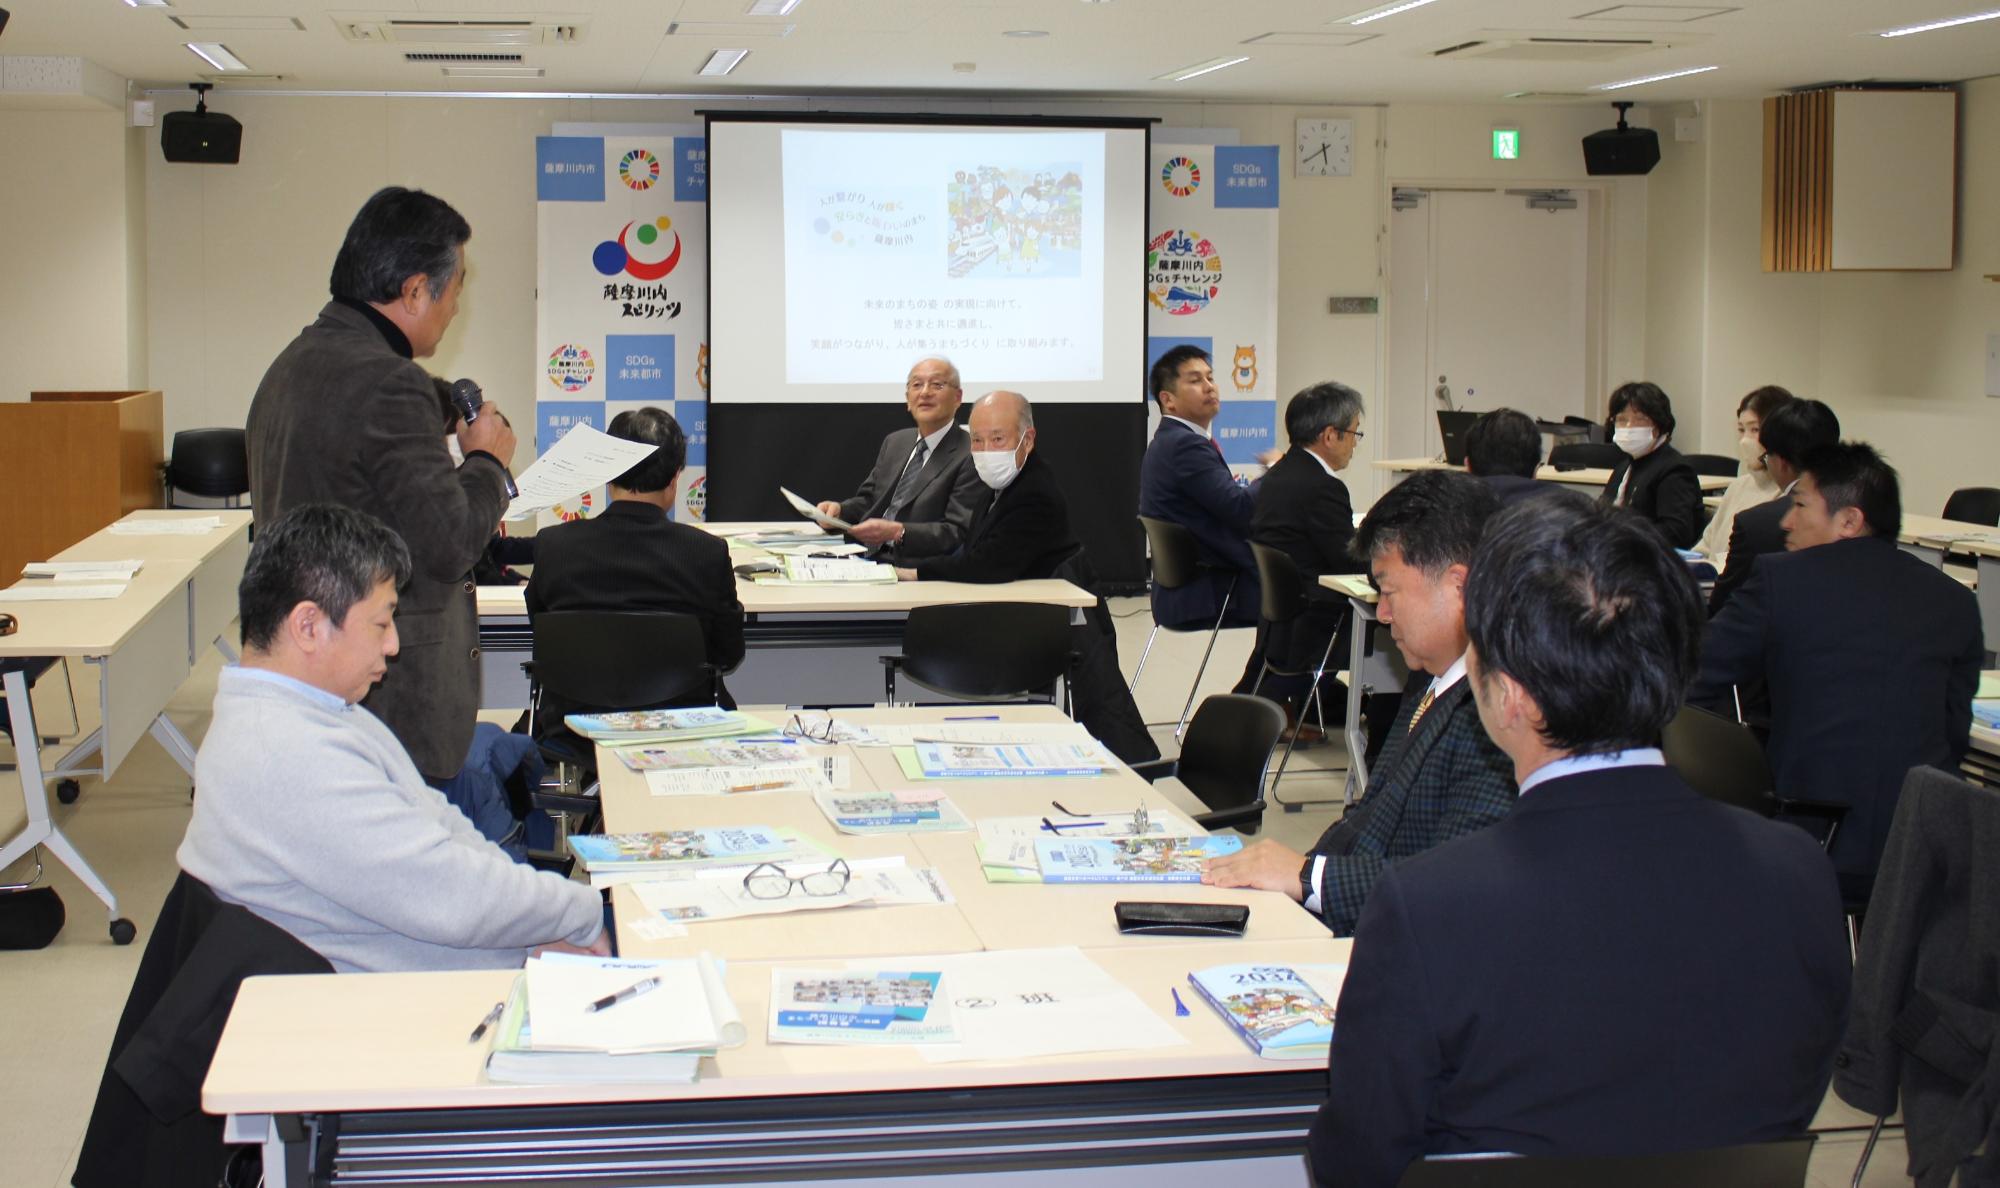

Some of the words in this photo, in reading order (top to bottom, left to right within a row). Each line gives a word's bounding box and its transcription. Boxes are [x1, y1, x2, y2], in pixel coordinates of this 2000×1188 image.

[544, 163, 596, 174] 薩摩川内市
[1232, 163, 1261, 175] SDGs
[1226, 177, 1267, 188] 未来都市
[1158, 259, 1204, 271] 薩摩川内
[603, 283, 668, 301] 薩摩川内
[621, 301, 682, 320] スピリッツ
[558, 360, 585, 368] 薩摩川内
[625, 355, 655, 366] SDGs
[619, 369, 662, 380] 未来都市
[1219, 427, 1268, 439] 薩摩川内市
